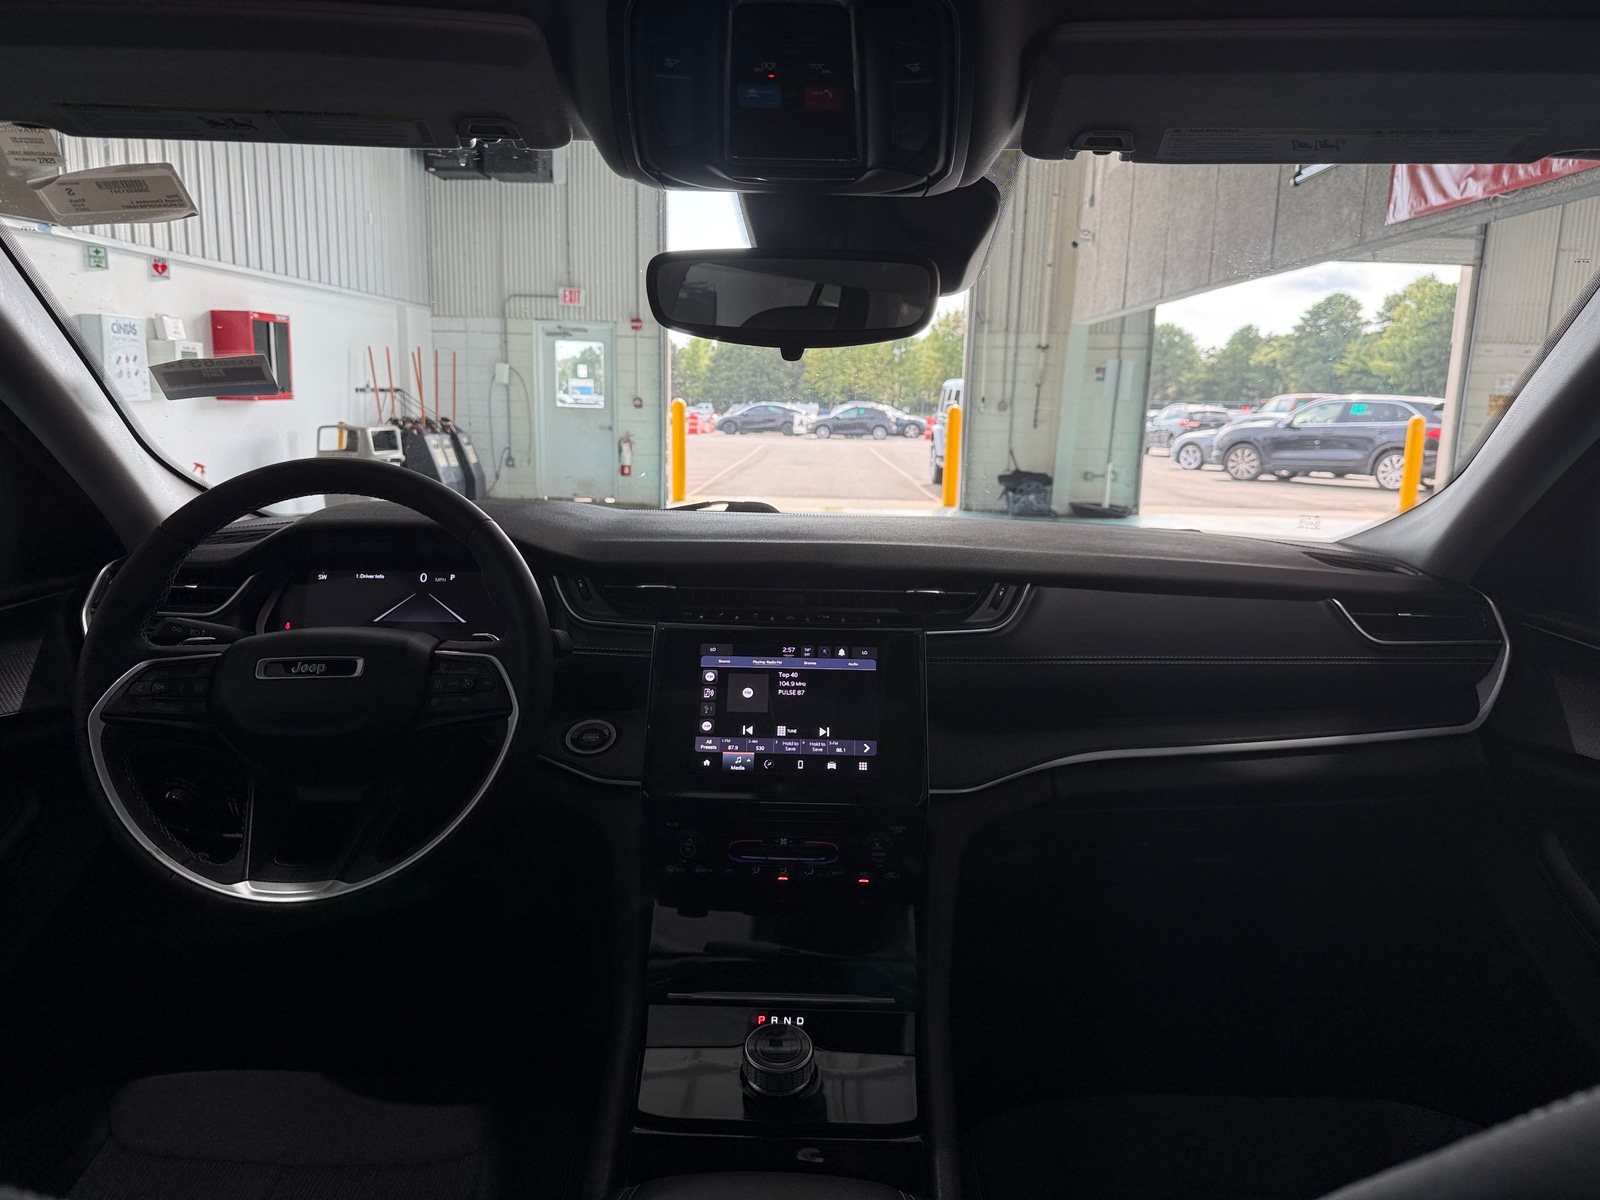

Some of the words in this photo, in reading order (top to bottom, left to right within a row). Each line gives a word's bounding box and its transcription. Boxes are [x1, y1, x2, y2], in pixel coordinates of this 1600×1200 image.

[562, 288, 580, 304] EXIT
[419, 572, 428, 583] 0
[449, 573, 456, 581] P
[782, 646, 796, 654] 2:57
[291, 662, 328, 676] Jeep
[757, 1015, 766, 1025] P
[770, 1015, 779, 1025] R
[783, 1016, 792, 1026] N
[796, 1016, 805, 1026] D
